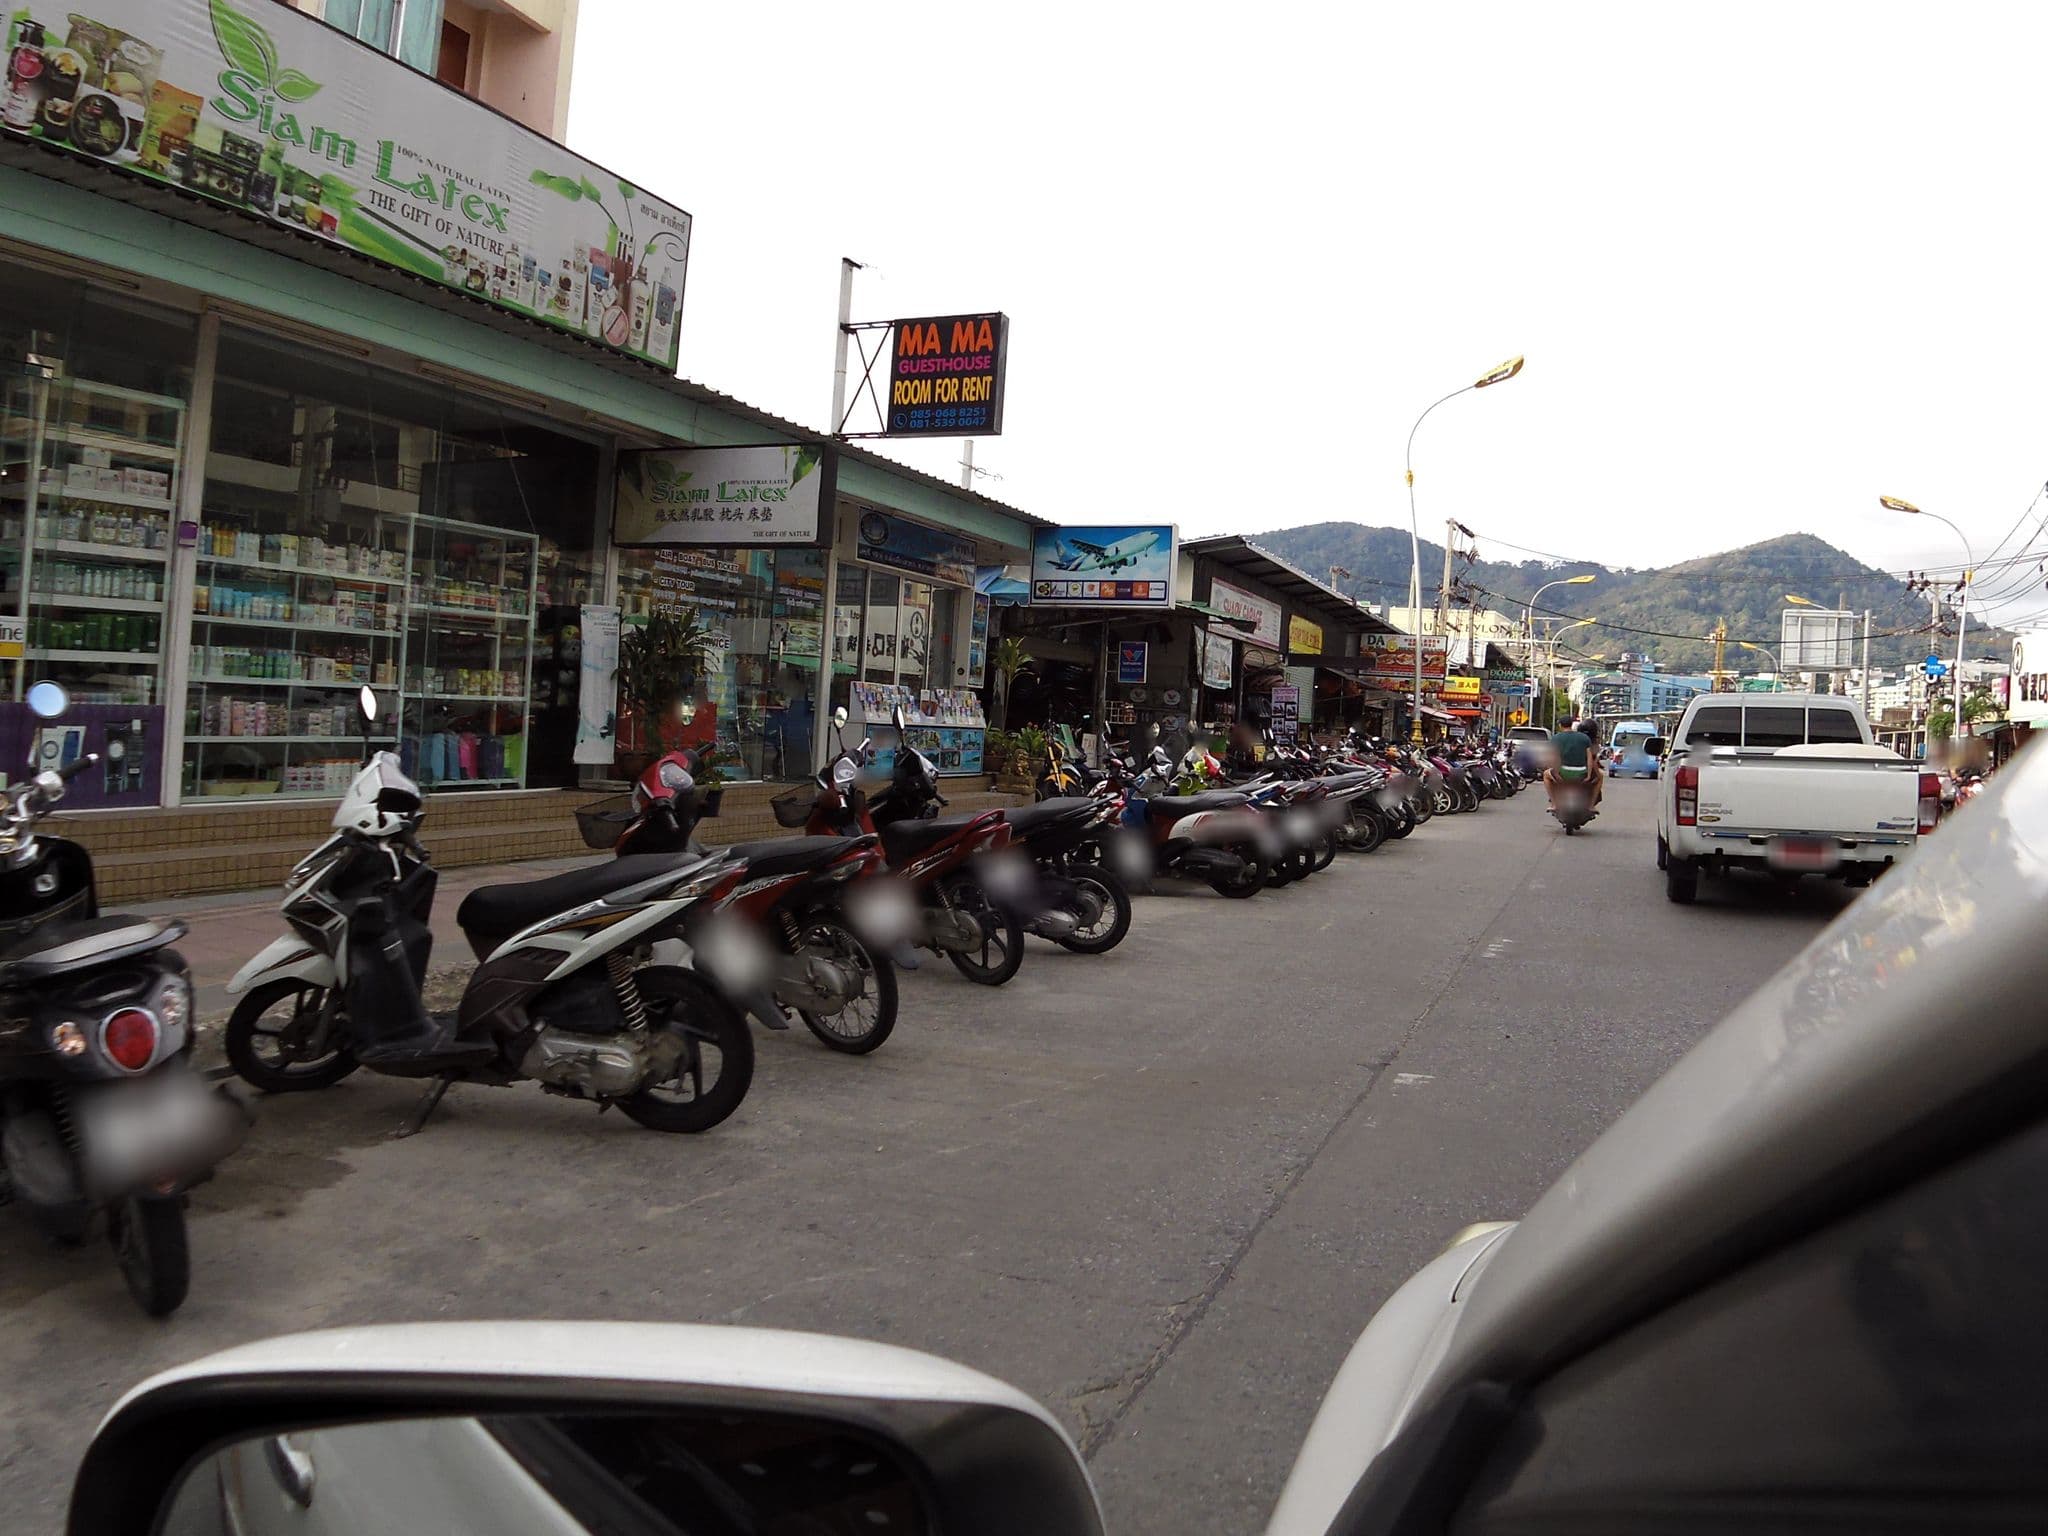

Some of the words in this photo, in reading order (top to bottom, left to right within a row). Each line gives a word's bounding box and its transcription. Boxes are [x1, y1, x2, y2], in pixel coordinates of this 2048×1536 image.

[210, 70, 357, 168] Siam
[372, 140, 510, 233] Latex
[397, 145, 423, 163] 100%
[427, 158, 475, 187] NATURAL
[478, 182, 512, 203] LATEX
[369, 189, 397, 213] THE
[401, 203, 432, 227] GIFT
[435, 218, 453, 235] OF
[456, 226, 505, 257] NATURE
[898, 322, 941, 356] MA
[950, 319, 994, 354] MA
[899, 356, 991, 373] GUESTHOUSE
[894, 379, 931, 406] ROOM
[935, 377, 959, 403] FOR
[962, 376, 993, 402] RENT
[959, 418, 986, 426] 0047
[960, 408, 986, 417] 8251
[651, 481, 709, 503] Siam
[716, 481, 788, 502] Latex
[679, 553, 698, 564] BOAT
[702, 559, 716, 568] BUS
[717, 561, 740, 573] TICKET
[659, 577, 676, 588] CITY
[677, 579, 695, 591] TOUR
[1490, 670, 1525, 679] EXCHANGE
